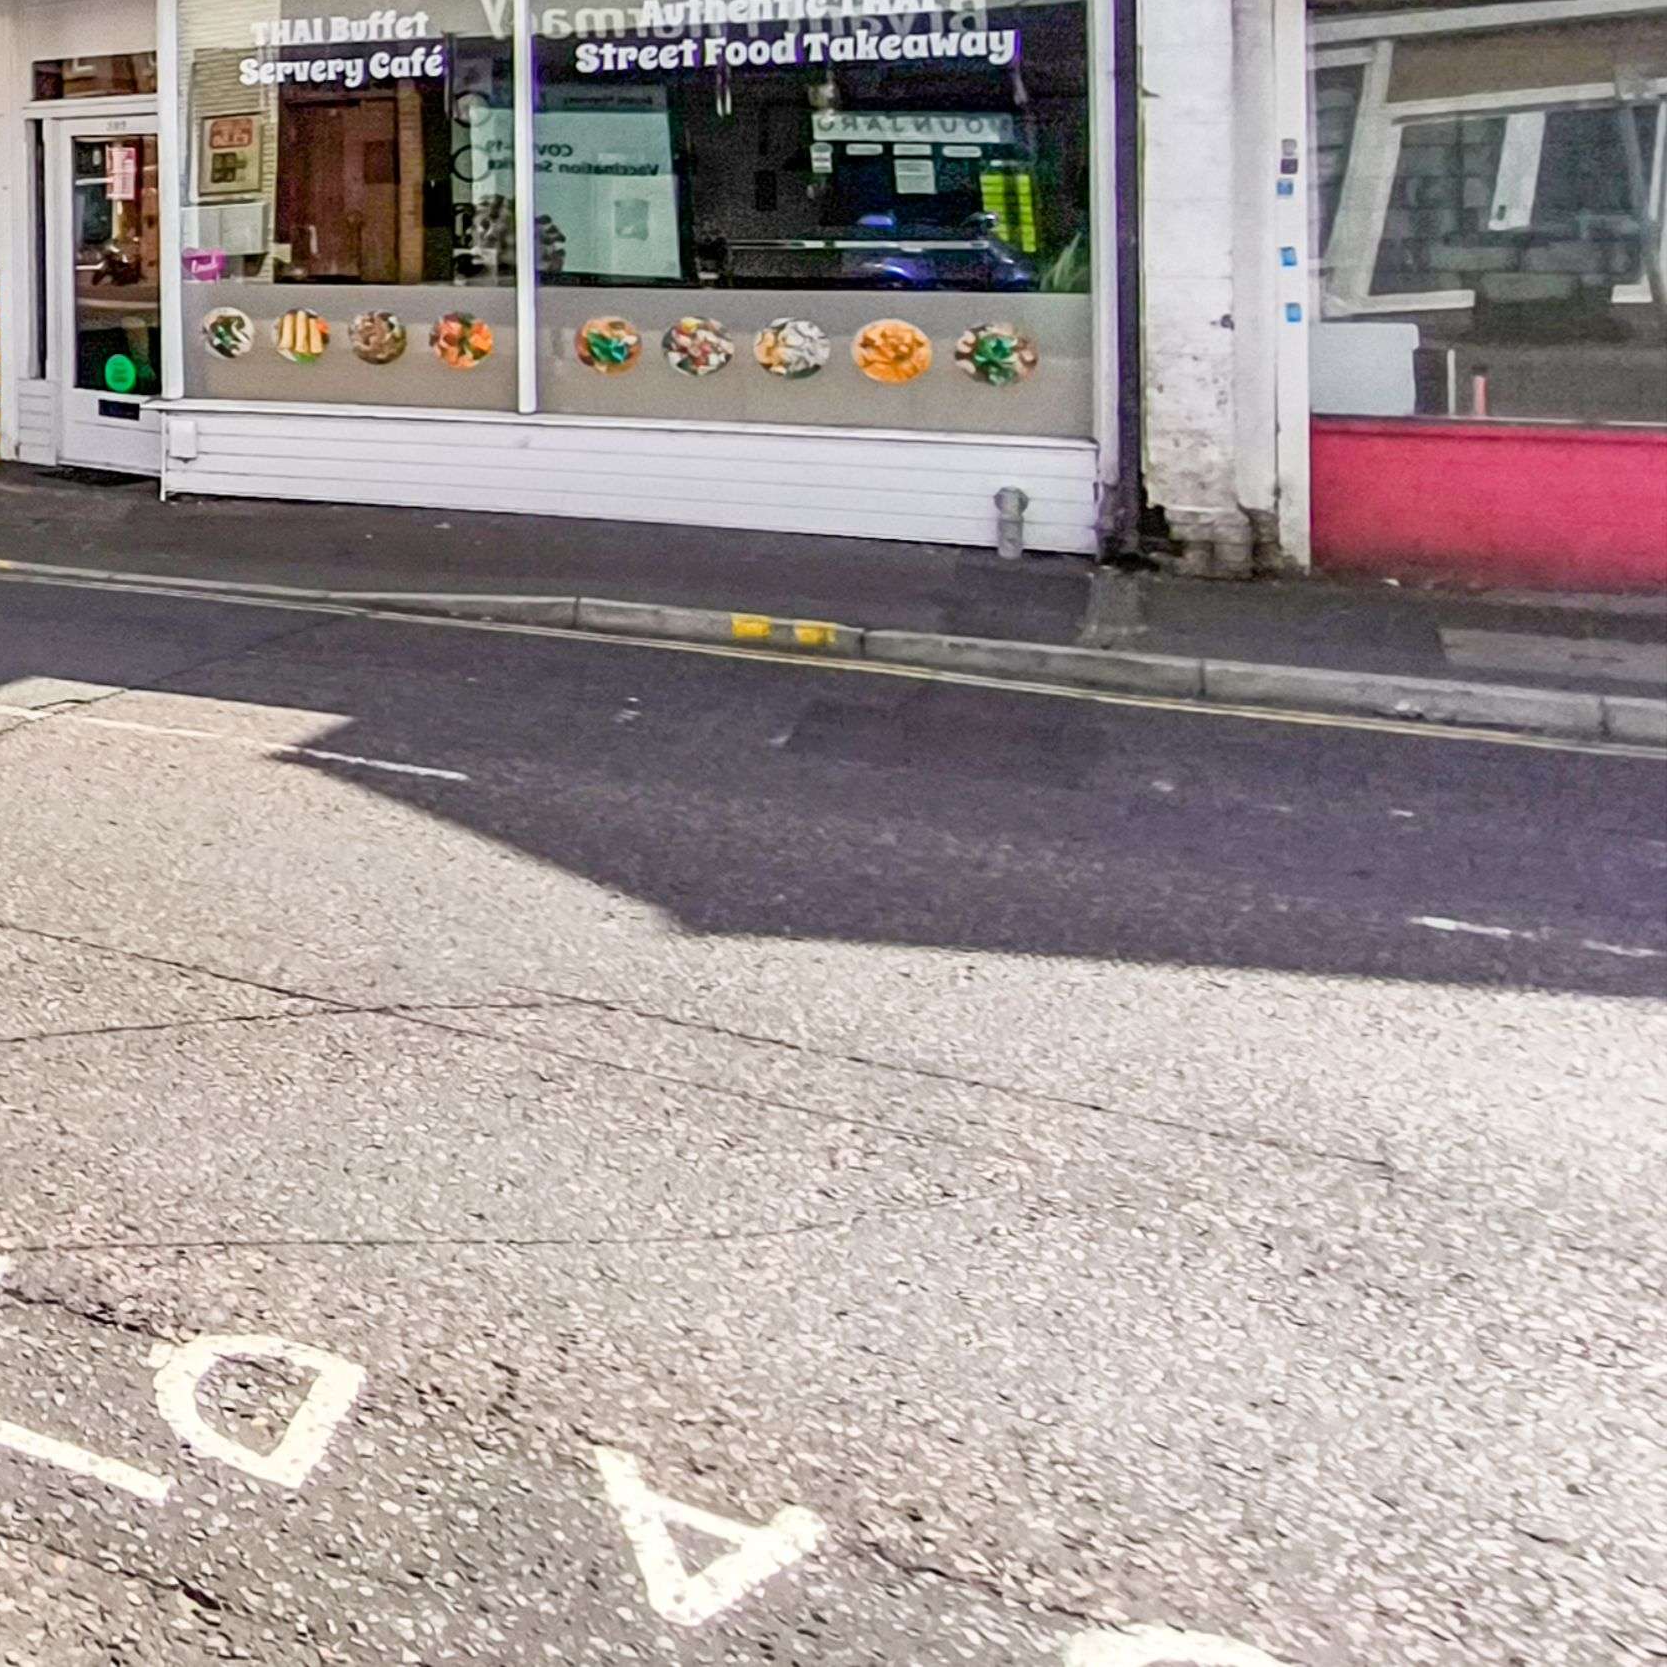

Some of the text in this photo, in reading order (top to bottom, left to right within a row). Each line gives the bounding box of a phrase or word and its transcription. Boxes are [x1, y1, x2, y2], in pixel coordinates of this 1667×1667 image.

[251, 10, 431, 47] THAI Buffet
[239, 44, 444, 88] Servery Café
[575, 30, 1017, 75] Street Food Takeaway
